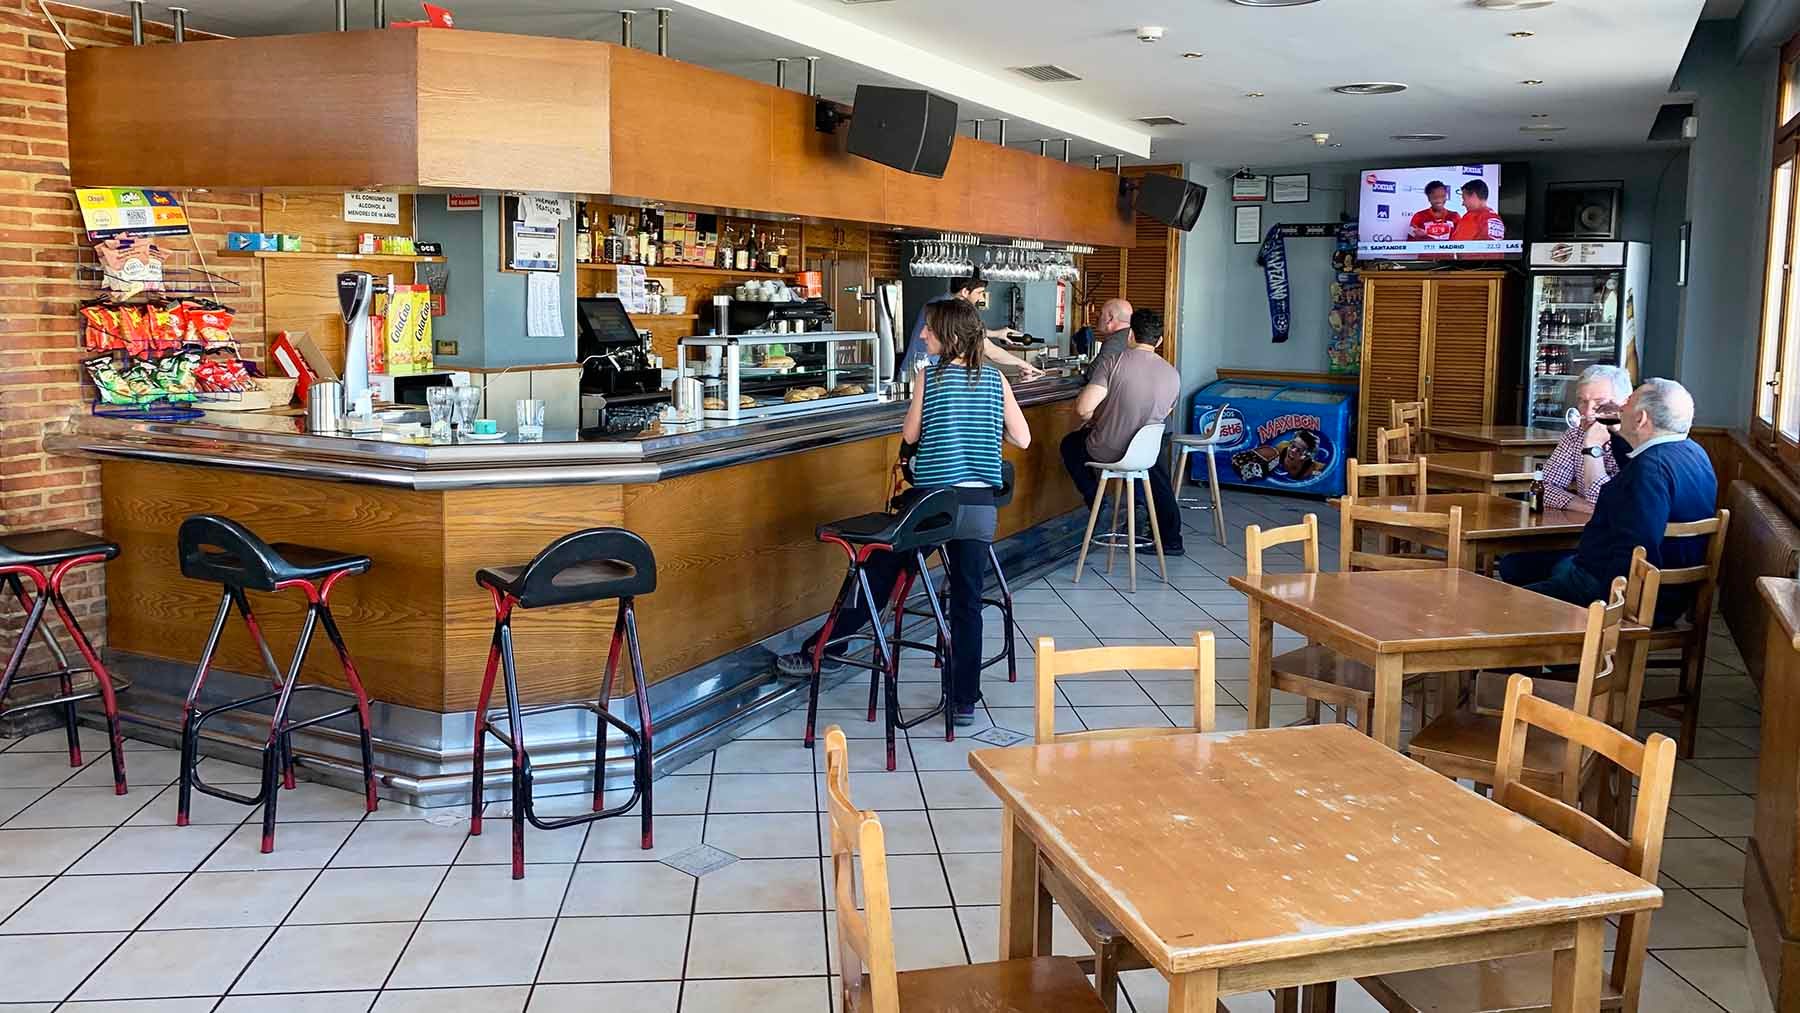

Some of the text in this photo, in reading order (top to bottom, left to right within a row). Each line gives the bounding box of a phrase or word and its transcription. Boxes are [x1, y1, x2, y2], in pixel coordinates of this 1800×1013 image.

[391, 303, 411, 344] ColaCao
[415, 302, 431, 342] ColaCao
[1257, 414, 1321, 444] MAXIBON
